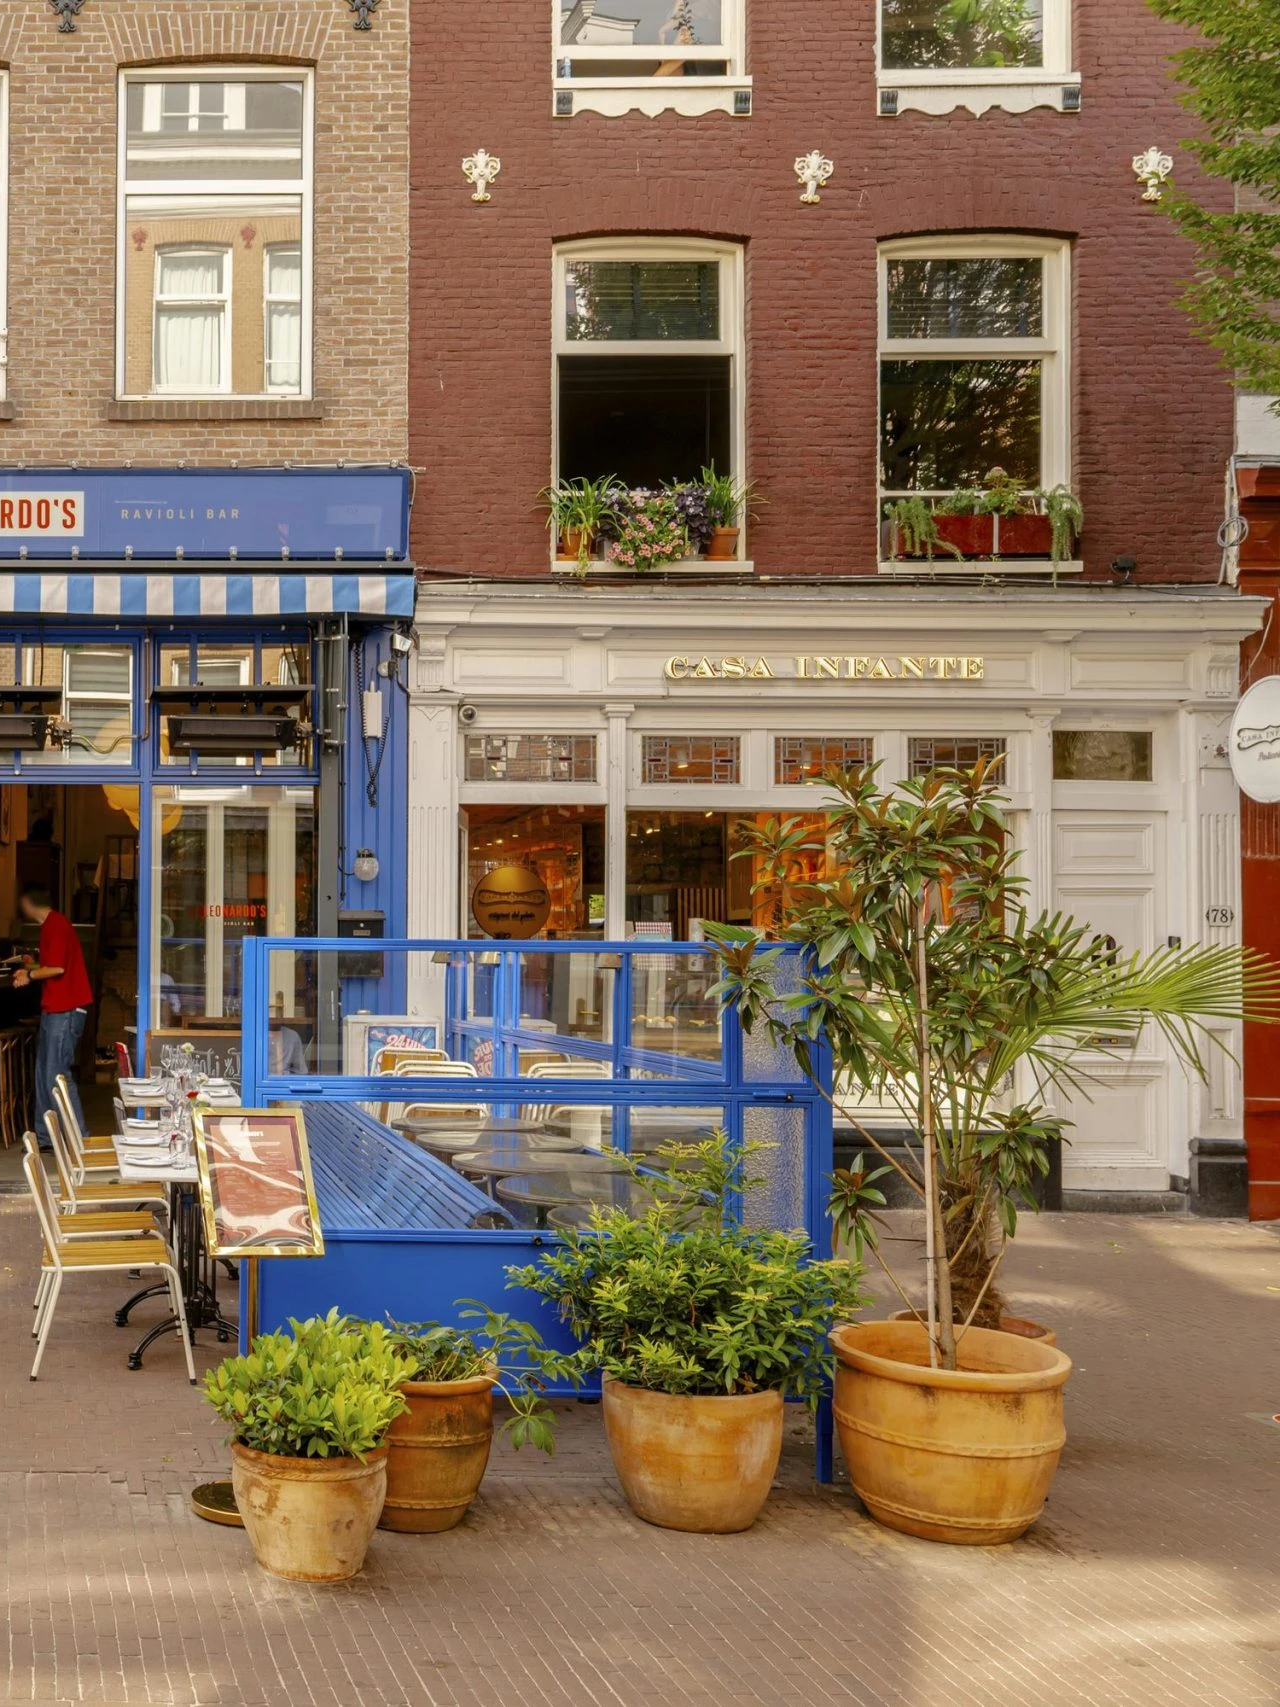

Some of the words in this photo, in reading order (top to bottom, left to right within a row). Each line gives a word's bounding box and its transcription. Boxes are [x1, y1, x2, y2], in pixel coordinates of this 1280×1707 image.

[120, 508, 195, 519] RAVIOLI
[206, 508, 240, 519] BAR
[663, 655, 775, 680] CASA
[794, 655, 985, 680] INFANTE
[1211, 908, 1229, 923] 78
